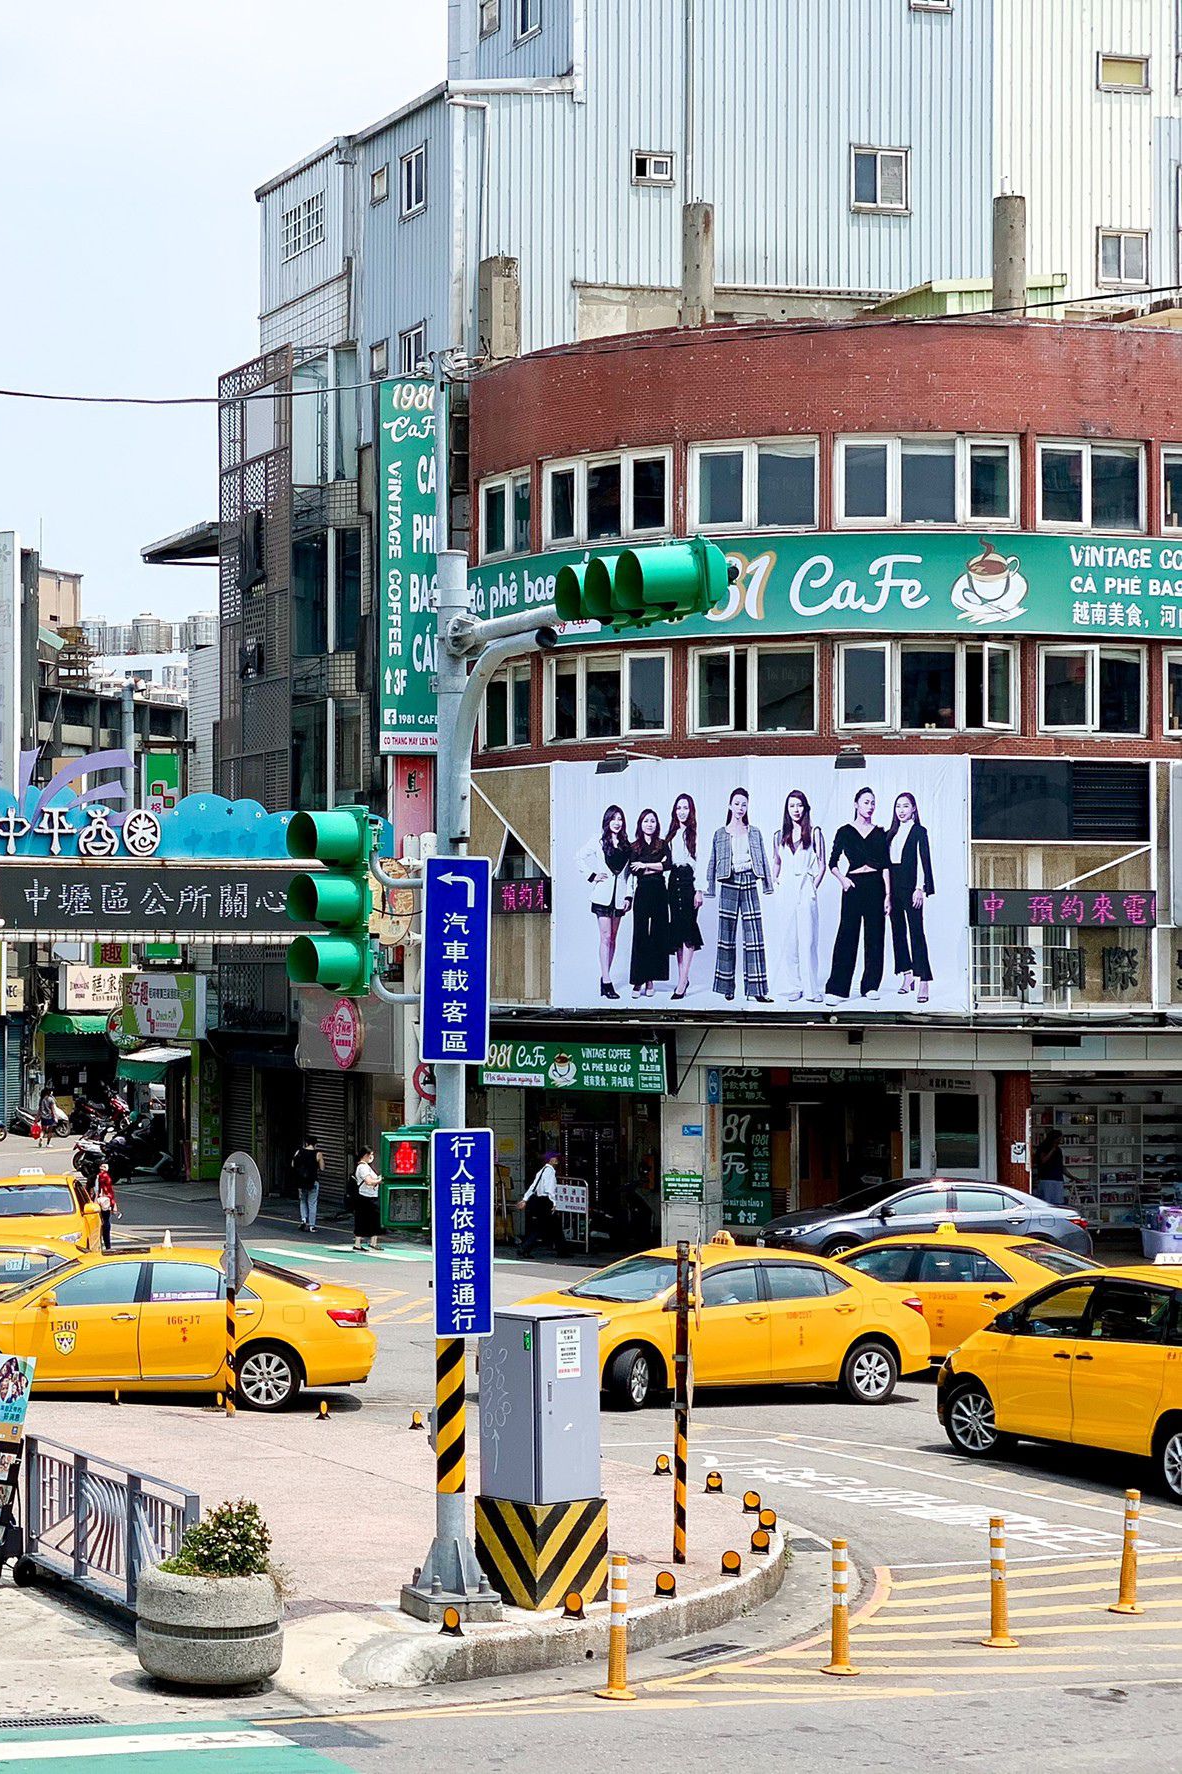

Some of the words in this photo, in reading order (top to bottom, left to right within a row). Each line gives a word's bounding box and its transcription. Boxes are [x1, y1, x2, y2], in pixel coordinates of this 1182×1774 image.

[789, 554, 931, 618] CaFe
[386, 568, 403, 657] COFFEE
[394, 668, 408, 697] 3F
[398, 714, 415, 725] 1981
[23, 878, 288, 919] 中壢區公所關心
[982, 891, 1005, 923] 中
[441, 912, 470, 1053] 汽車載客區
[516, 1045, 547, 1068] CaFe
[608, 1048, 631, 1060] COFFEE
[648, 1049, 659, 1063] 3F
[746, 1212, 757, 1224] 3F
[450, 1135, 476, 1331] 行人請依號誌通行
[50, 1321, 79, 1331] 1560
